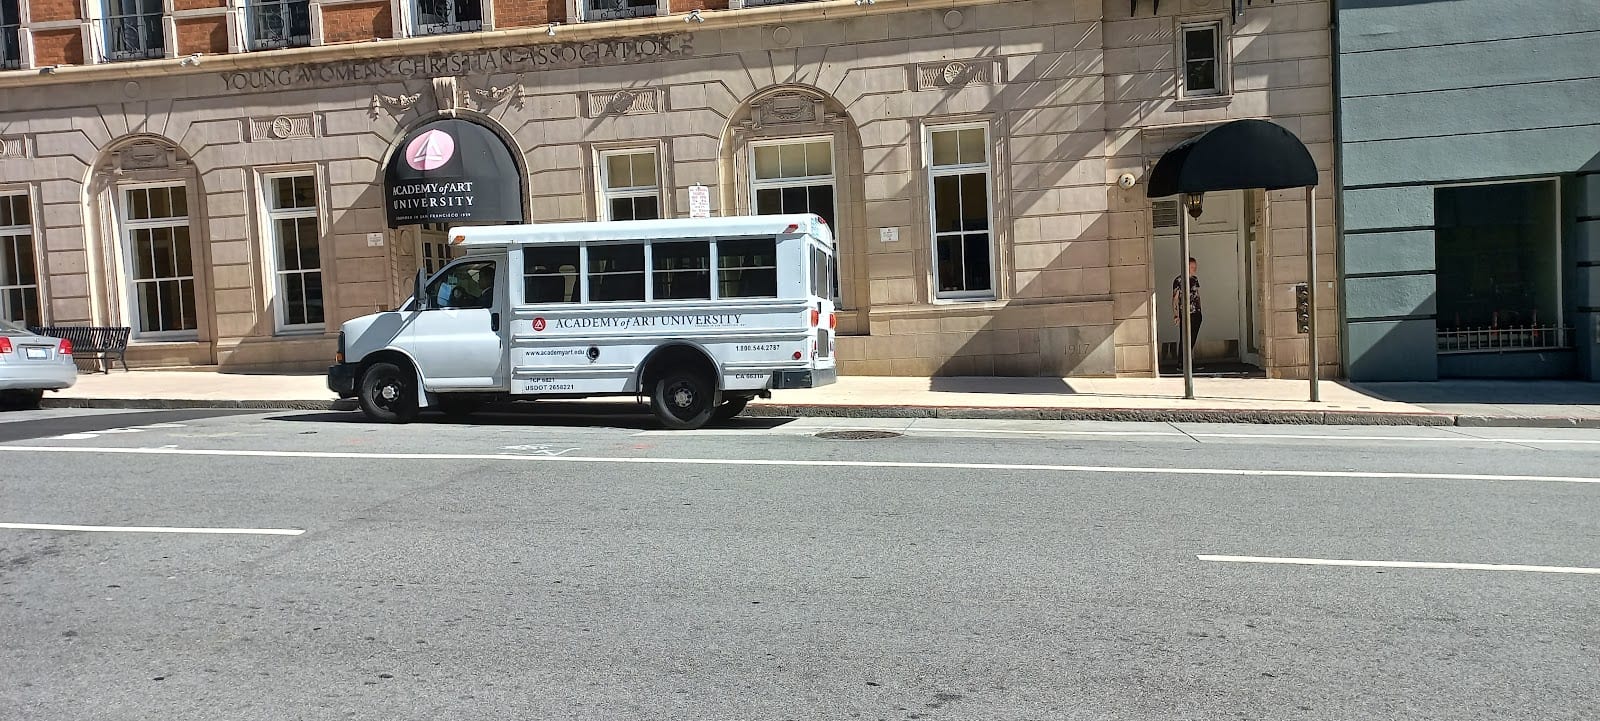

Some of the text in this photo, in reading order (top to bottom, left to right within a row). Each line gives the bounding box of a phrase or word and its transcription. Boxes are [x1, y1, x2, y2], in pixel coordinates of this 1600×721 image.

[220, 39, 673, 90] YOUNG WOMENS CHRISTIAN ASSOCIATION
[392, 181, 473, 196] ACADEMY of ART
[393, 196, 474, 210] UNIVERSITY
[555, 313, 743, 330] ACADEMY of ART UNIVERSITY
[525, 349, 585, 357] www.academyart.edu
[1063, 343, 1090, 356] 1917
